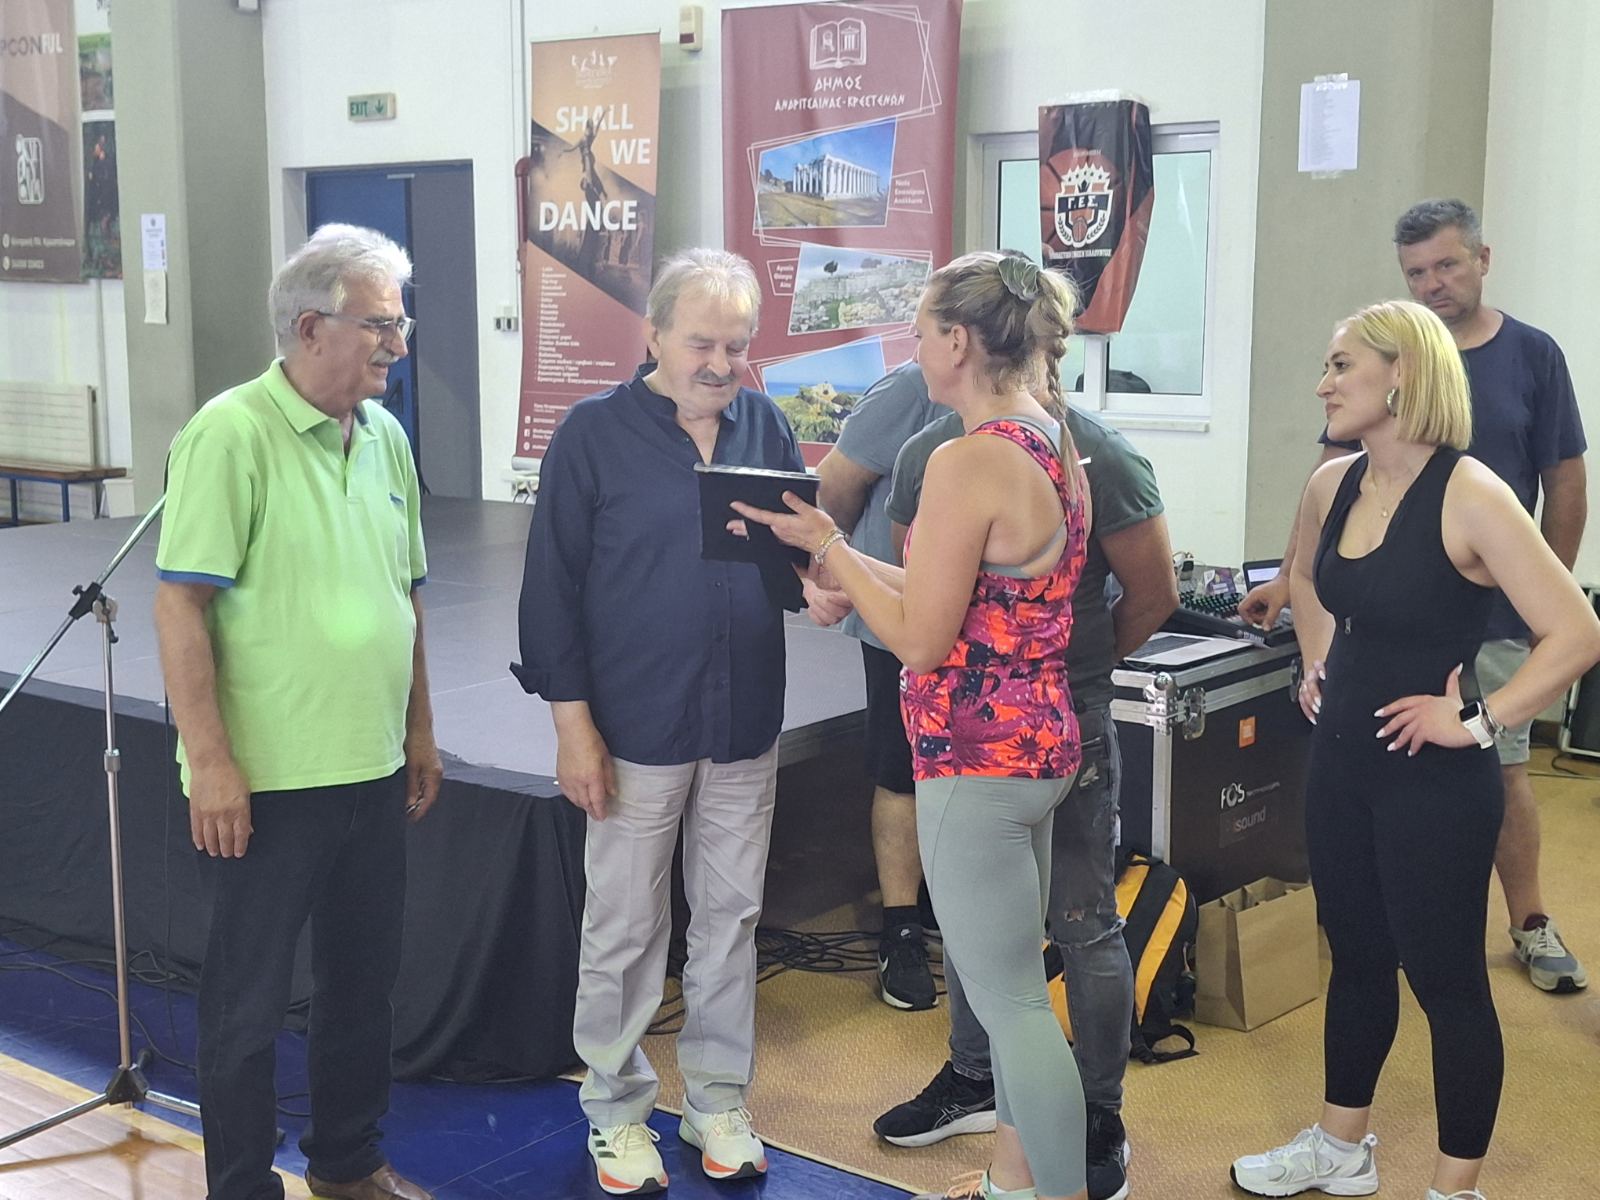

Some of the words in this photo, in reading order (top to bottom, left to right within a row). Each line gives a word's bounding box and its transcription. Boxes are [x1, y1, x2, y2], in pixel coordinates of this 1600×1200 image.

[814, 75, 862, 92] ΔΗΜΟΣ
[555, 104, 634, 133] SHALL
[610, 137, 651, 165] WE
[538, 200, 638, 232] DANCE
